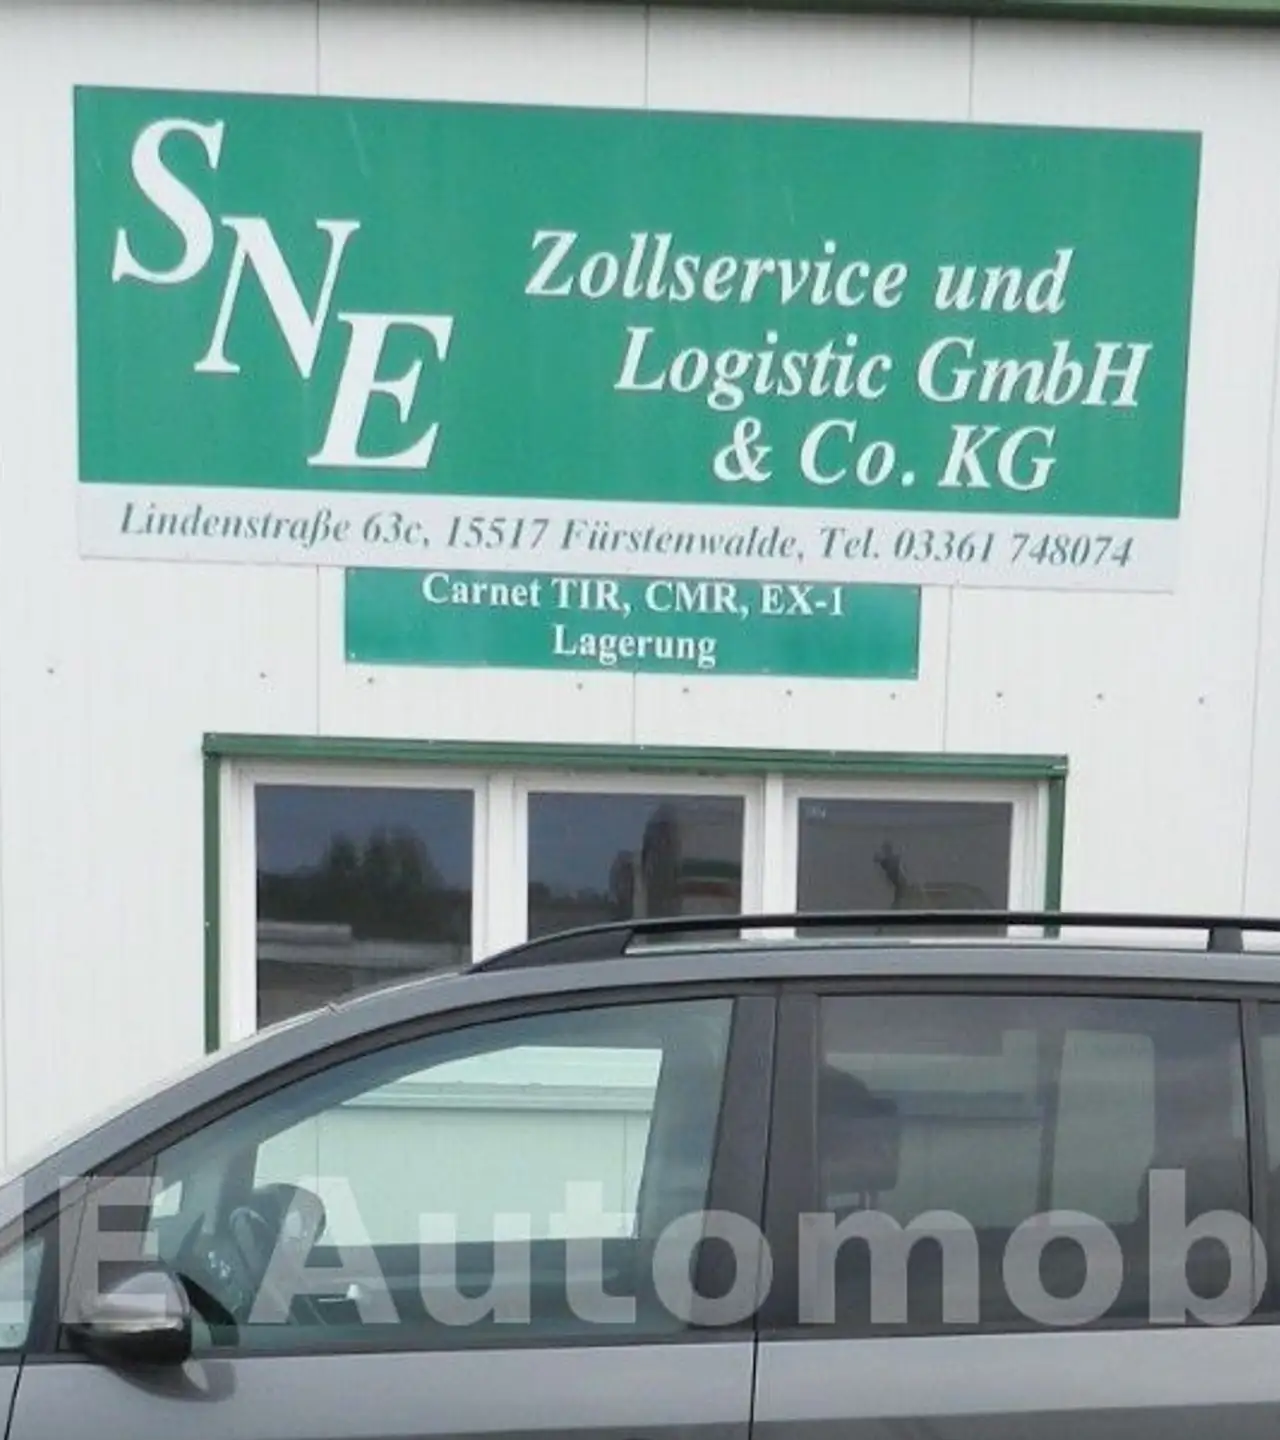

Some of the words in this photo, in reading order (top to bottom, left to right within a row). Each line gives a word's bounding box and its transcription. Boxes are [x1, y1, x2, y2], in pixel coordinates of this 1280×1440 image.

[112, 117, 454, 469] SNE
[523, 229, 909, 309] Zollservice
[933, 248, 1076, 314] und
[613, 326, 893, 412] Logistic
[917, 335, 1153, 408] GmbH
[711, 416, 773, 483] &
[799, 419, 916, 488] Co.
[937, 424, 1058, 492] KG
[119, 501, 352, 549] Lindenstraße
[362, 511, 431, 549] 63c,
[446, 514, 551, 551] 15517
[559, 517, 806, 564] Fürstenwalde,
[819, 526, 880, 560] Tel.
[892, 528, 995, 564] 03361
[1011, 532, 1135, 568] 748074
[421, 571, 542, 607] Carnet
[551, 576, 631, 617] TIR,
[644, 581, 750, 620] CMR,
[761, 585, 845, 617] EX-1
[551, 626, 718, 669] Lagerung
